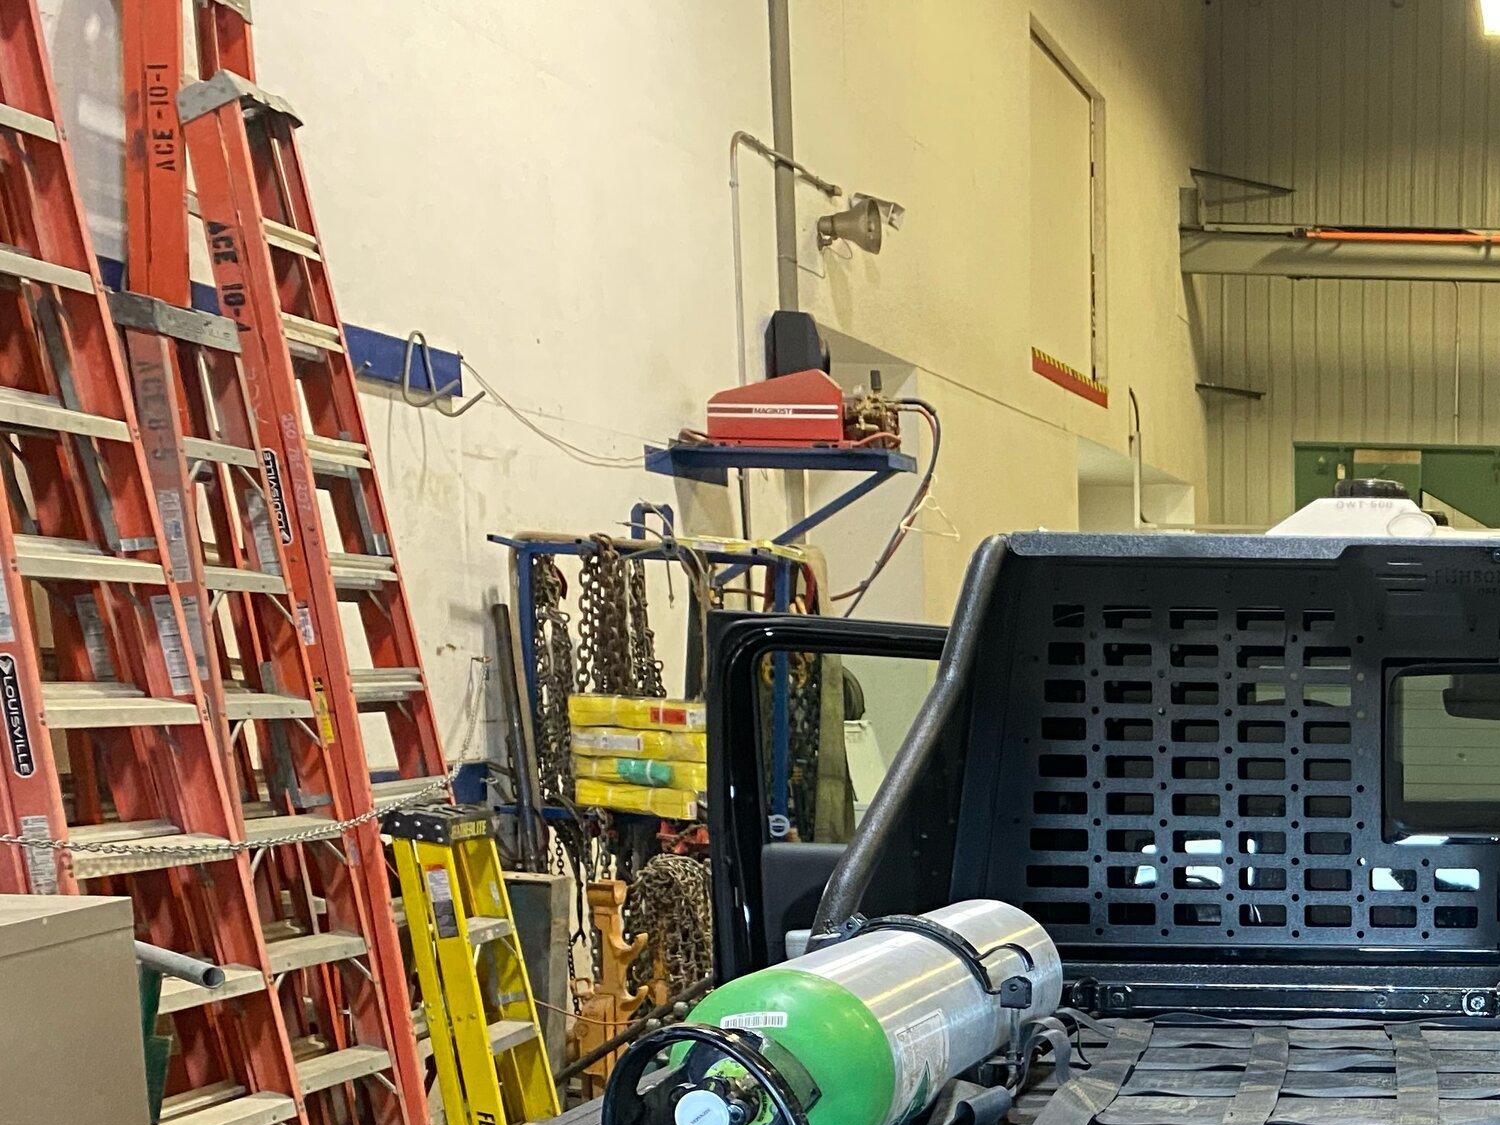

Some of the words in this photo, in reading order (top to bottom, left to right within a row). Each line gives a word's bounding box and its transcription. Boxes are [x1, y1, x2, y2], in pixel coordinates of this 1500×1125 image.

[152, 128, 176, 172] ACE
[207, 221, 238, 264] ACE
[3, 675, 30, 777] LOUISVILLE
